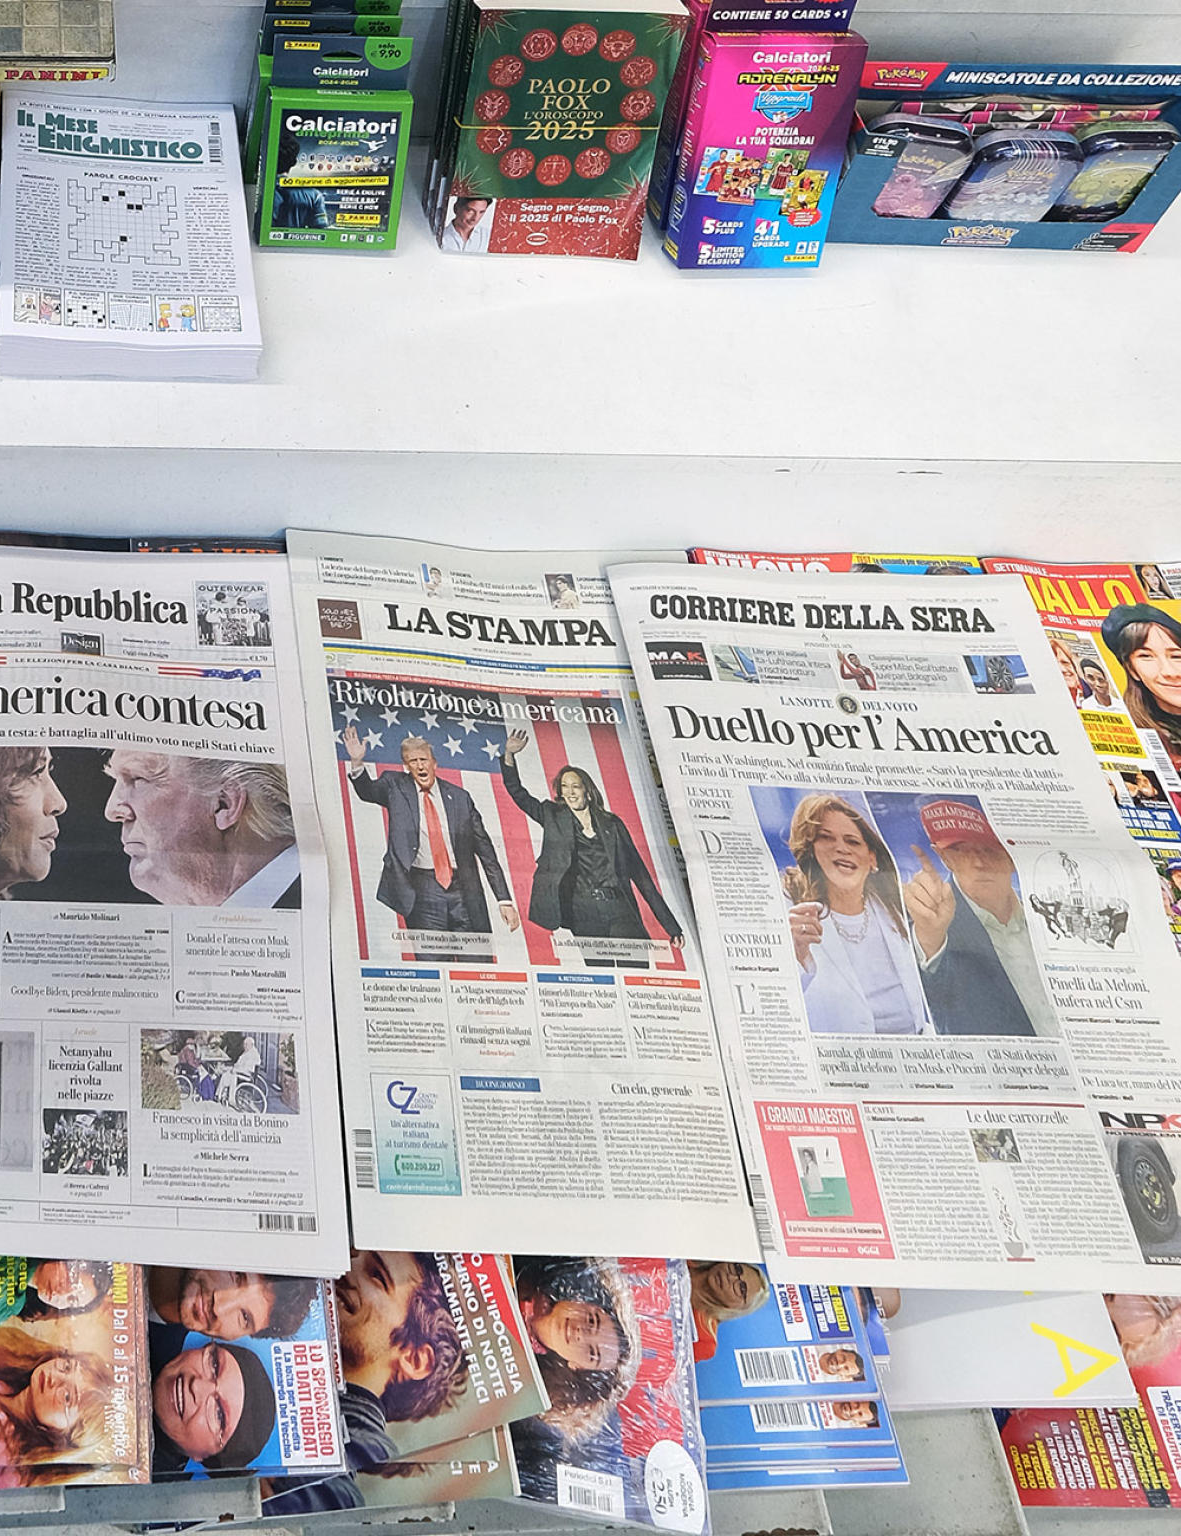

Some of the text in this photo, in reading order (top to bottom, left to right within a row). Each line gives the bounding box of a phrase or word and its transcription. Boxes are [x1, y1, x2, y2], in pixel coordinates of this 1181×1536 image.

[713, 10, 831, 20] CONTIENE 50 CARDS
[379, 50, 401, 58] 9,90
[753, 52, 831, 64] Calciatori
[313, 67, 369, 77] Calciatori
[738, 72, 837, 85] ADRENALYN
[946, 71, 1181, 86] MINISCATOLE DA COLLEZIONE
[527, 78, 611, 94] PAOLO
[541, 95, 591, 110] FOX
[18, 109, 98, 133] IL MESE
[524, 111, 603, 120] L'OROSCOPO
[286, 115, 397, 135] Calciatori
[525, 121, 596, 141] 2025
[755, 127, 799, 136] POTENZIA
[38, 126, 204, 159] ENIGMISTICO
[737, 136, 815, 145] LA TUA SQUADRA!
[520, 203, 613, 214] Segno per segno,
[520, 214, 618, 224] 2025 Paolo Fox
[12, 582, 188, 625] Repubblica
[649, 594, 995, 633] CORRIERE DELLA SERA
[383, 604, 617, 647] LA STAMPA
[333, 680, 622, 725] Rivoluzione americana
[115, 693, 267, 730] contesa
[664, 705, 1059, 758] Duello per l'America
[60, 1046, 112, 1059] Netanyahu
[70, 1075, 101, 1086] rivolta
[807, 1108, 856, 1125] MAESTRI
[475, 1273, 523, 1395] ALL'IPOCRISIA
[465, 1352, 490, 1406] FELICI
[309, 1364, 335, 1457] SPIONAGGIO
